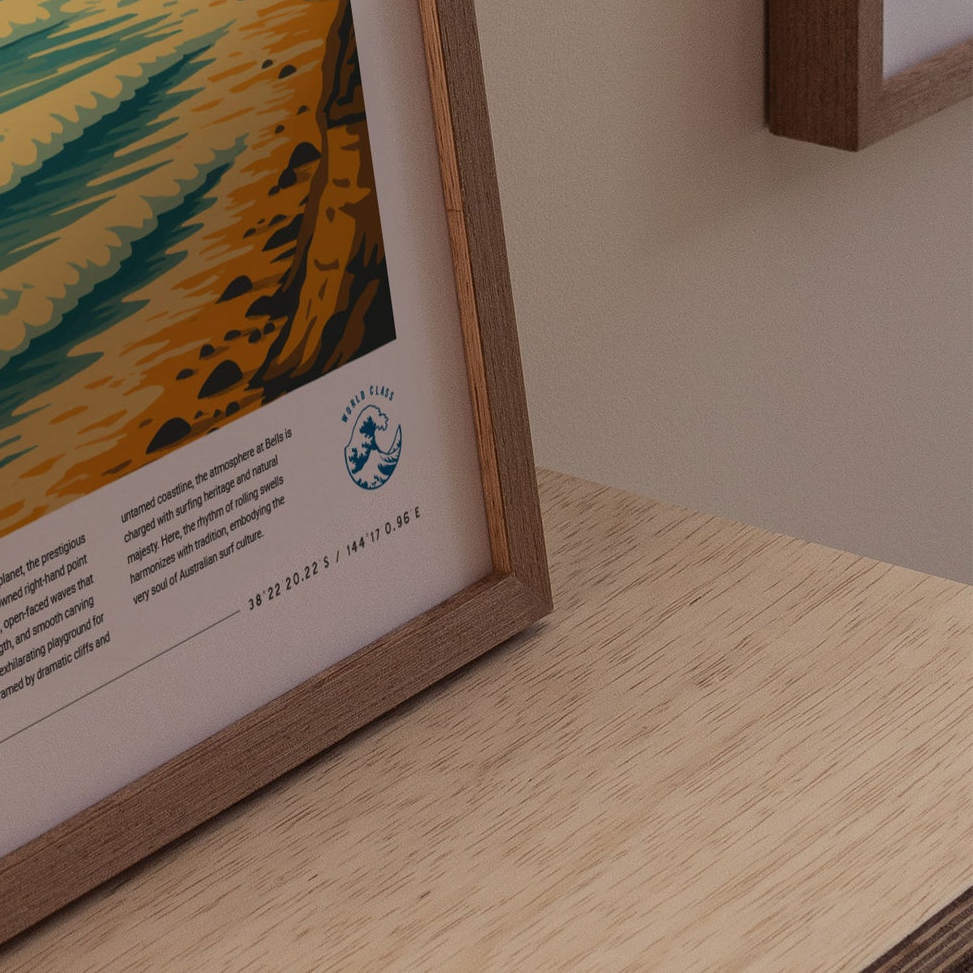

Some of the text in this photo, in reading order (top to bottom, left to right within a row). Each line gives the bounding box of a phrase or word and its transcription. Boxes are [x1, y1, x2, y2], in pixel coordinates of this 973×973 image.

[341, 385, 394, 423] WORLD CLASS
[120, 428, 293, 524] untamed coastline, the atmosphere at Bells is
[123, 453, 279, 544] charged with surfing heritage and natural
[126, 475, 285, 565] majesty. Here, the rhythm of rolling swells
[129, 495, 286, 585] harmonizes with tradition, embodying the
[23, 563, 66, 596] right-hand
[66, 554, 88, 577] point
[25, 557, 41, 572] the
[40, 534, 87, 568] prestigious
[132, 529, 265, 605] very soul of Australian surf culture.
[3, 595, 50, 630] open-faced
[49, 584, 77, 605] waves
[76, 573, 95, 591] that
[14, 626, 32, 646] and
[31, 611, 64, 637] smooth
[63, 596, 95, 619] carving
[24, 673, 36, 687] by
[36, 653, 73, 681] dramatic
[73, 641, 95, 660] cliffs
[94, 630, 111, 649] and
[46, 617, 92, 655] playground
[91, 612, 105, 627] for
